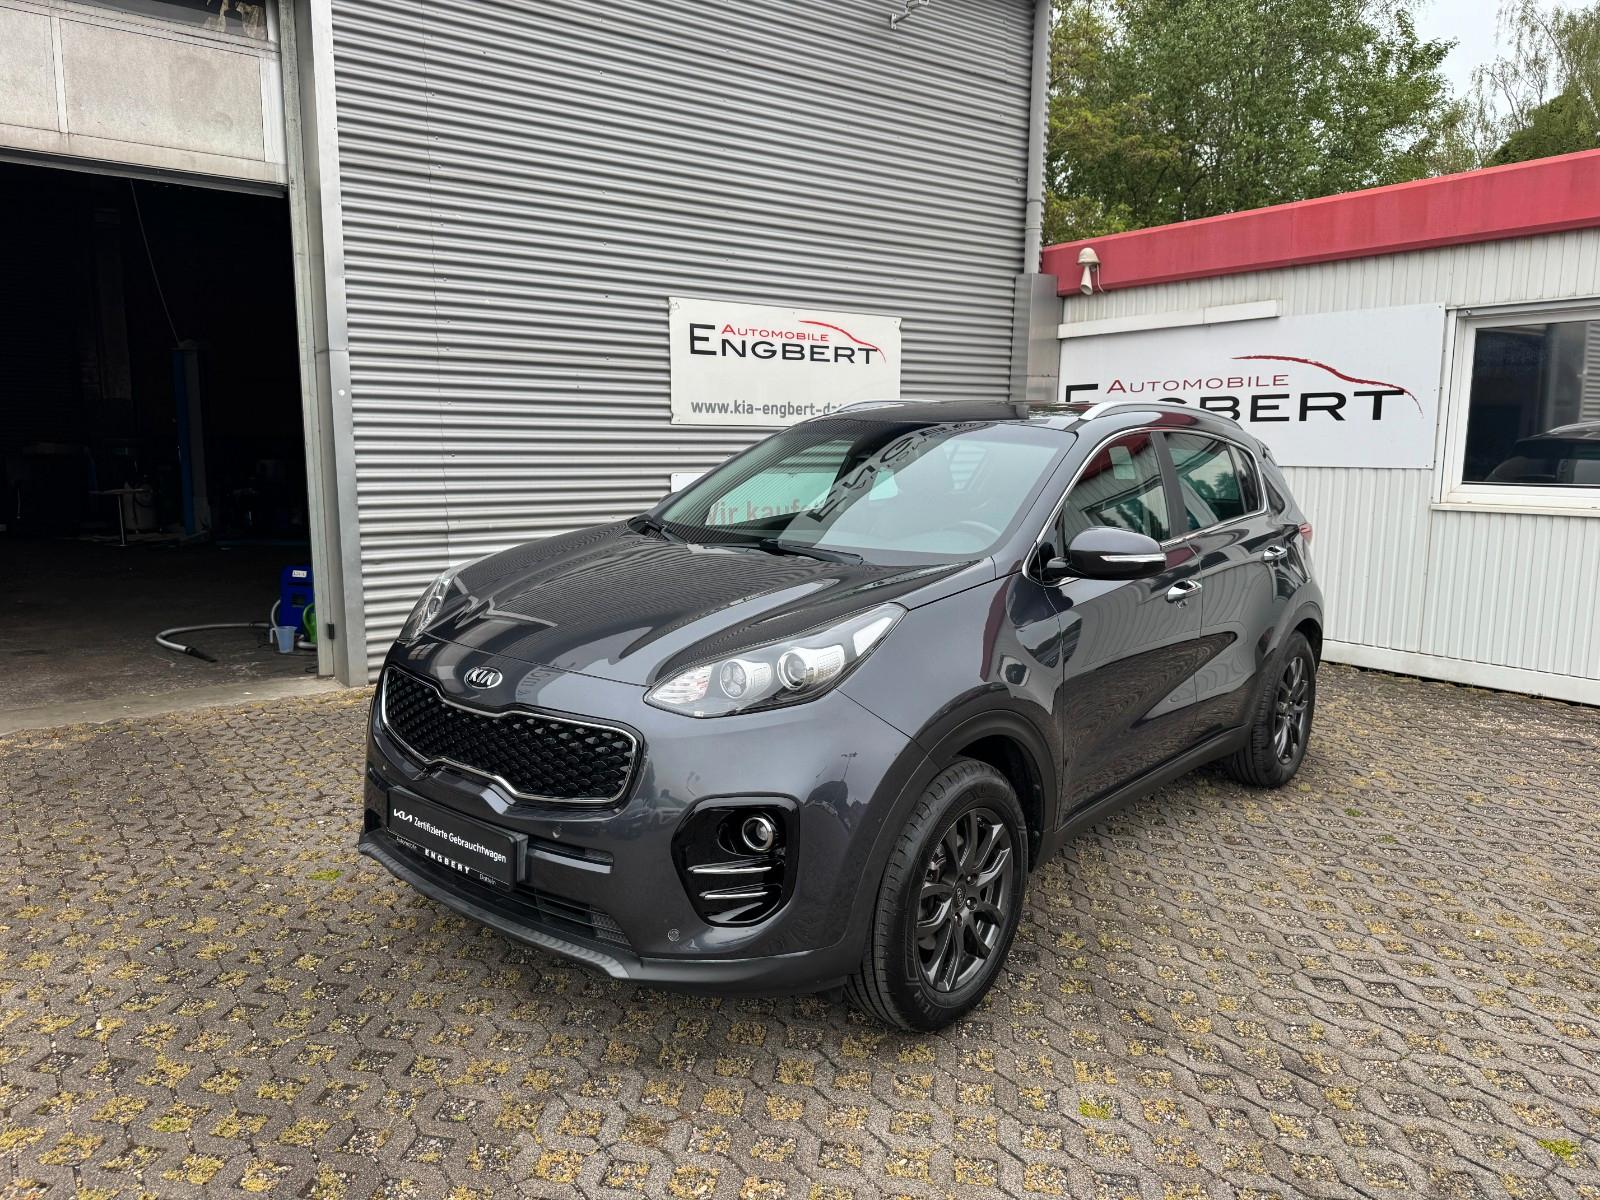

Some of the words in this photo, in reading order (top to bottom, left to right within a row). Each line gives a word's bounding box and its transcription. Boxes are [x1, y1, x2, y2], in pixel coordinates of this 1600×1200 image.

[691, 400, 842, 418] www.kia-engbert-d
[1065, 383, 1404, 422] BERT
[424, 848, 470, 874] ENGBERT
[449, 832, 507, 864] Gebrauchtwagen
